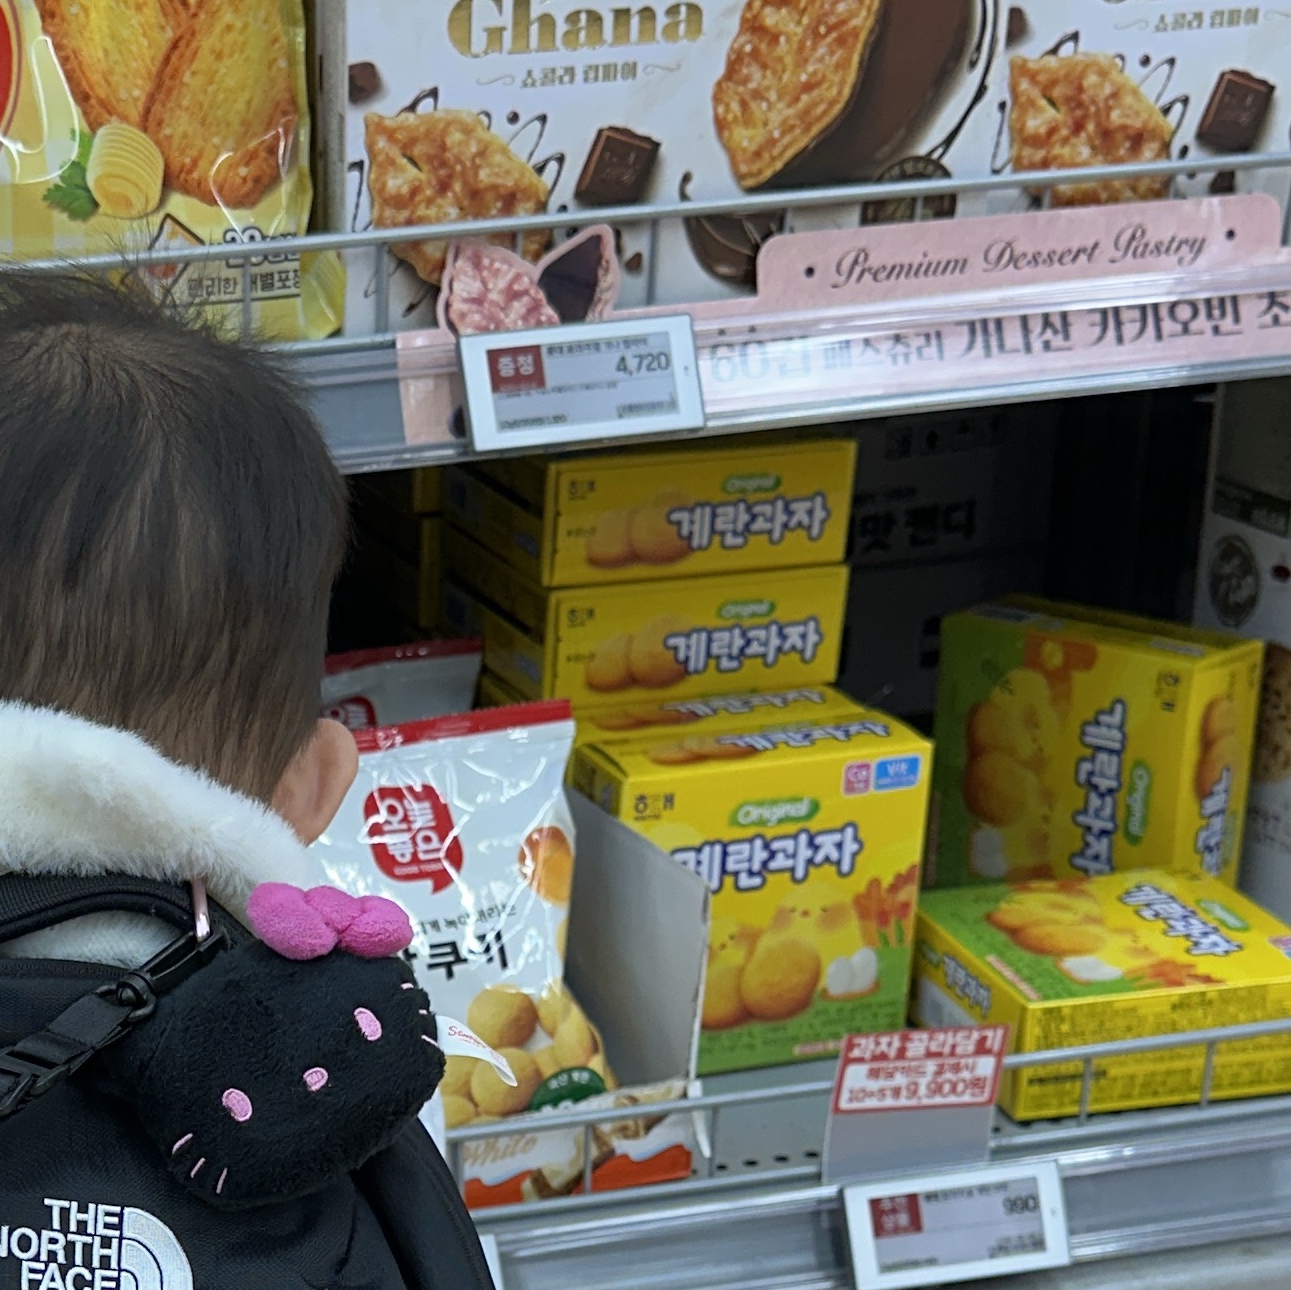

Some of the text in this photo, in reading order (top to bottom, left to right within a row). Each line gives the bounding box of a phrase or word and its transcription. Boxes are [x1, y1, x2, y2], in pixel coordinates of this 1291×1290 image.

[447, 0, 705, 58] Ghana
[831, 222, 1207, 289] Premium Dessert Pastry
[1088, 295, 1243, 346] 카카오빈
[616, 351, 671, 377] 4,720
[665, 490, 830, 551] 계란과자
[663, 614, 823, 675] 계란과자
[737, 797, 811, 826] Original
[848, 1034, 901, 1061] 과자
[905, 1027, 1005, 1059] 골라담기
[44, 1198, 121, 1237] THE
